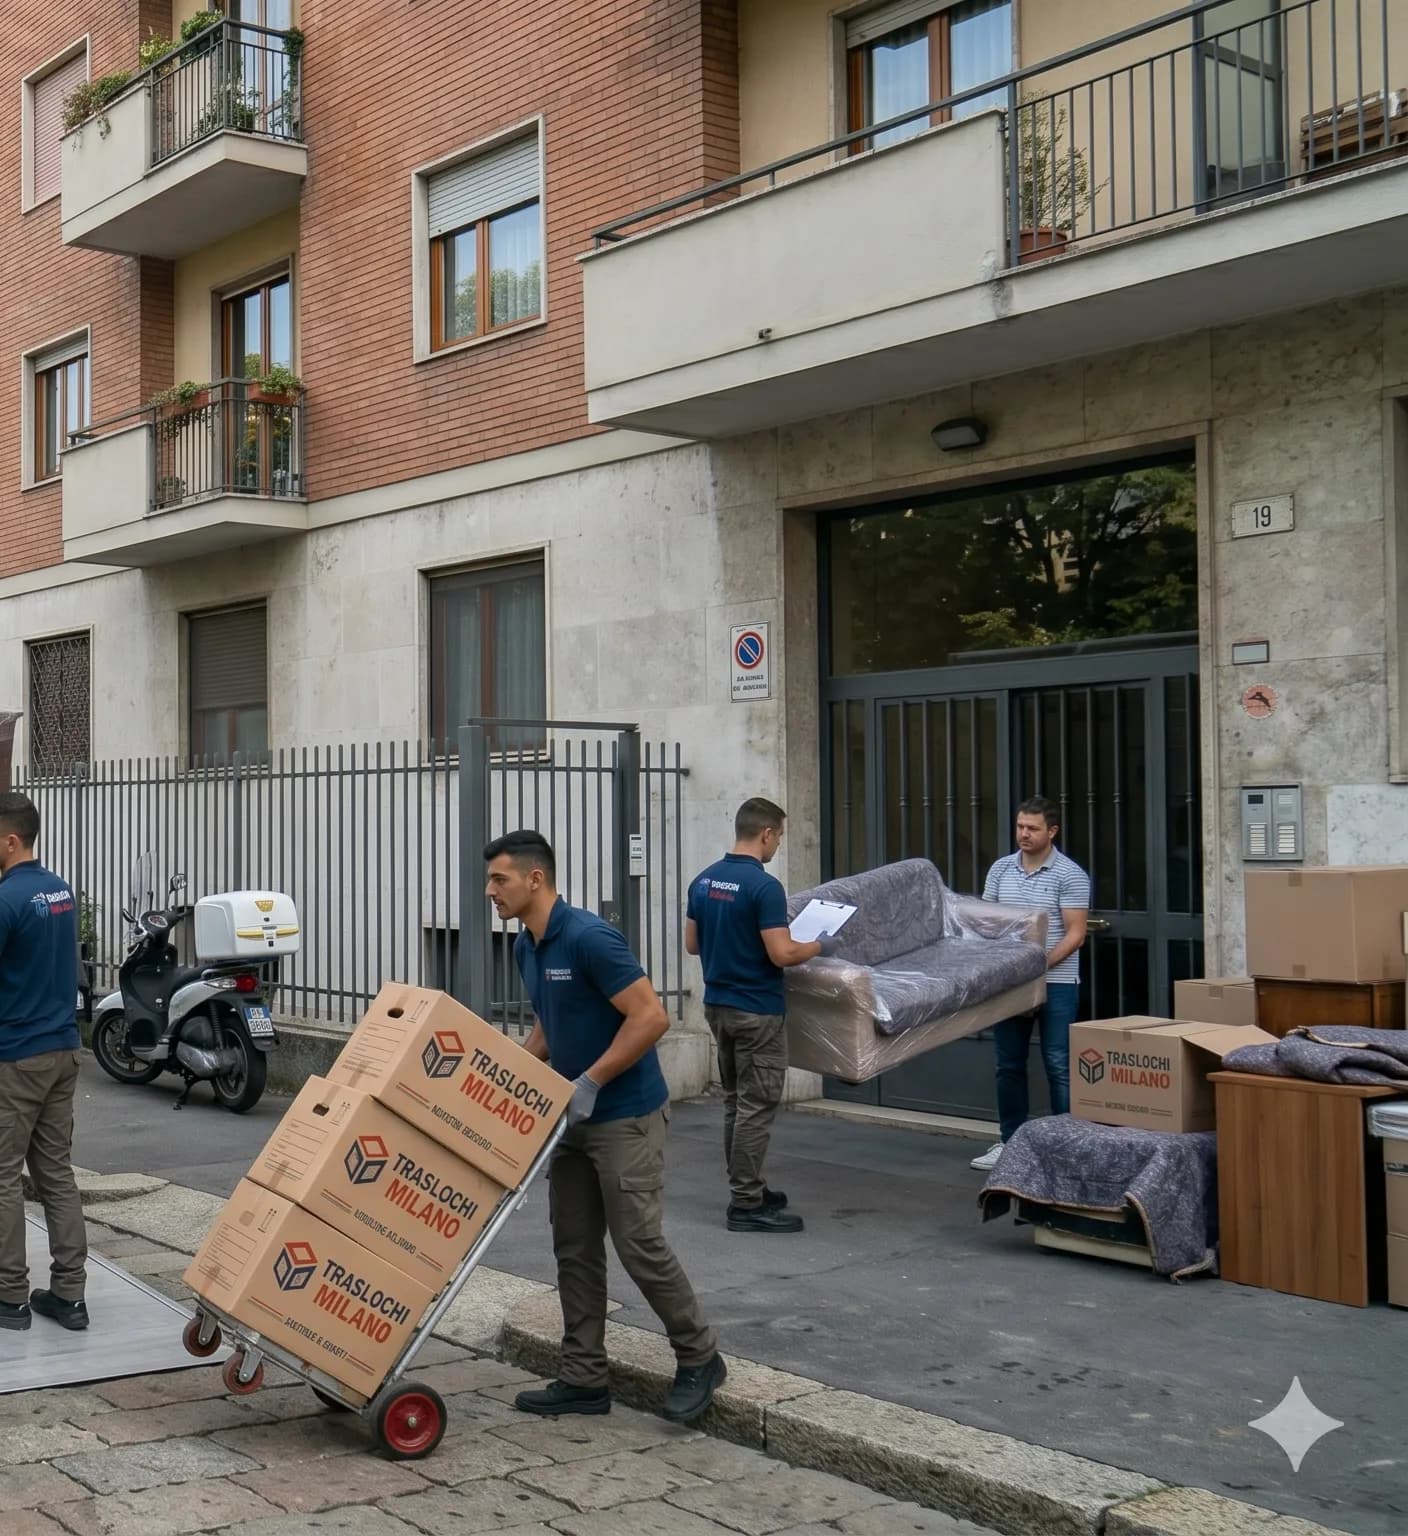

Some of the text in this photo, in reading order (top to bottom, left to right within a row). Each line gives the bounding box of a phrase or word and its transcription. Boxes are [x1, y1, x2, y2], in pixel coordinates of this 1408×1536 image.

[1253, 505, 1271, 528] 19
[469, 1048, 554, 1117] TRASLOCHI
[1106, 1051, 1170, 1071] TRASLOCHI
[1111, 1067, 1171, 1089] MILANO
[459, 1072, 536, 1136] MILANO
[384, 1178, 461, 1240] MILANO
[392, 1153, 479, 1221] TRASLOCHI
[312, 1284, 393, 1344] MILANO
[322, 1259, 412, 1326] TRASLOCHI
